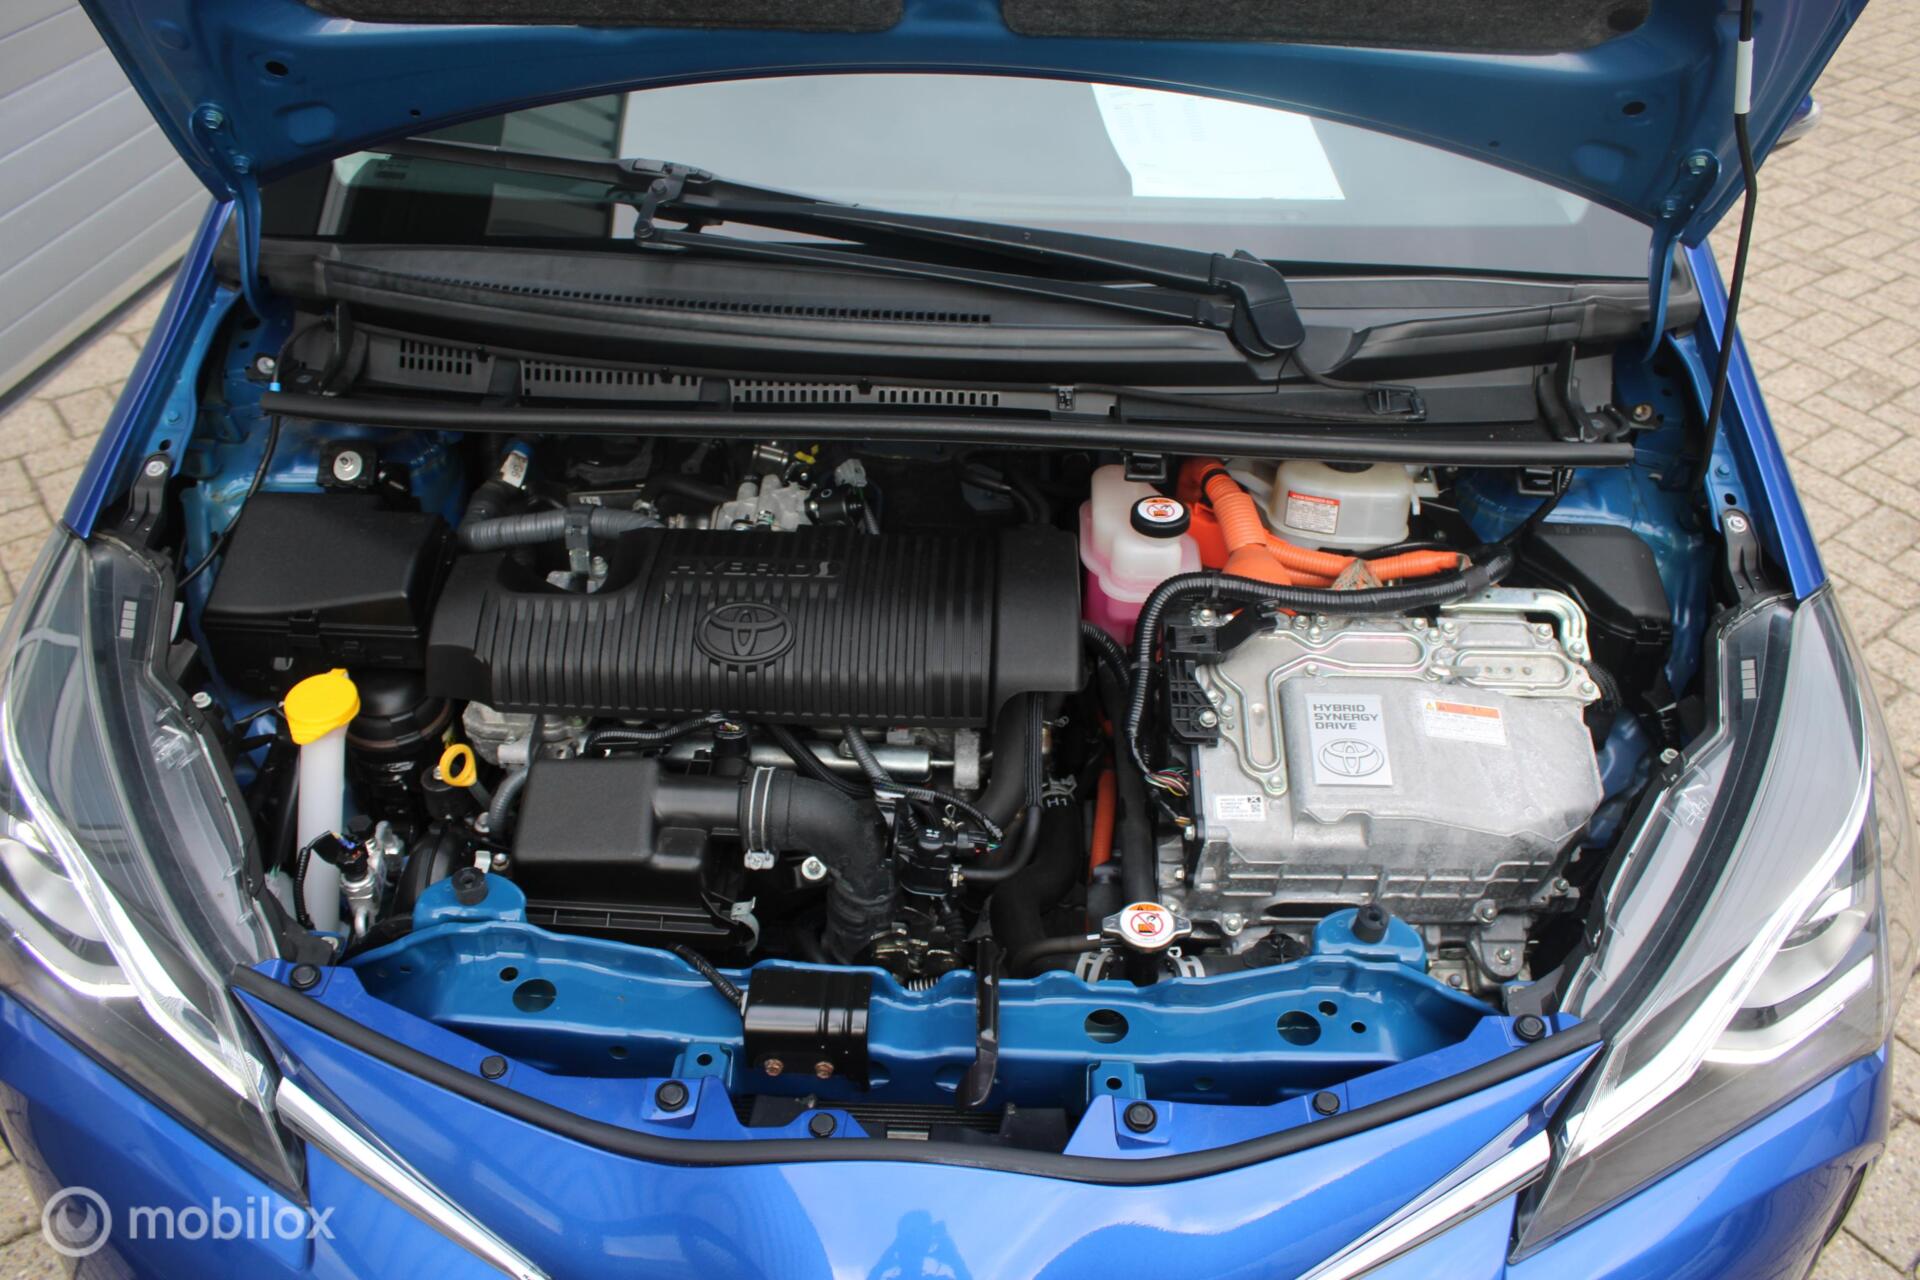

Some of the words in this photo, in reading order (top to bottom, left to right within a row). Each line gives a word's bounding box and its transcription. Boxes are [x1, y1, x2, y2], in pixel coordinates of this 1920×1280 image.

[1313, 704, 1366, 712] HYBRID
[1314, 713, 1378, 721] SYNERGY
[1315, 722, 1358, 730] DRIVE
